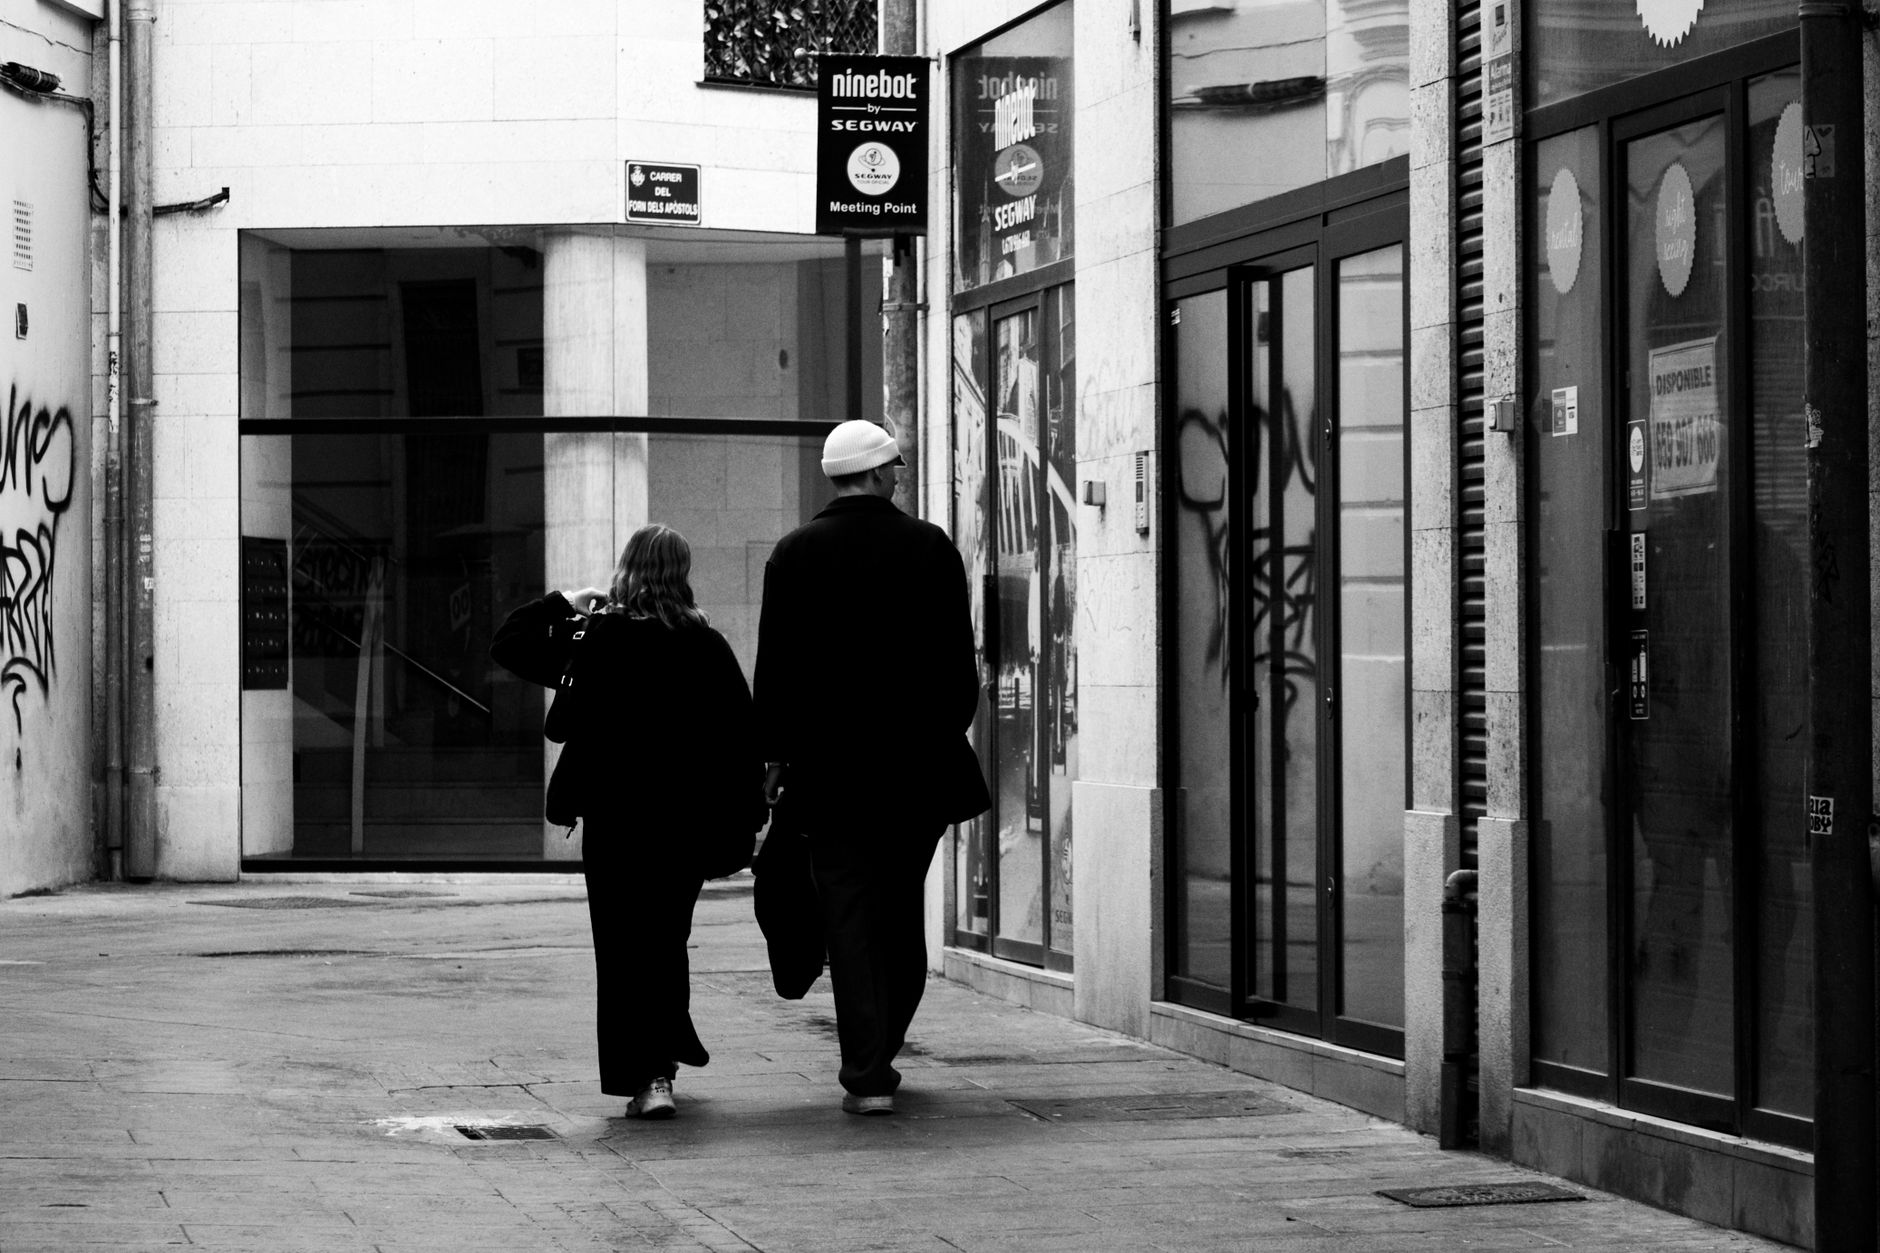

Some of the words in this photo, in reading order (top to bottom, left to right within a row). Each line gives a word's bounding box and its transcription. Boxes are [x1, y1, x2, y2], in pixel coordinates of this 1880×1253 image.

[832, 68, 917, 99] ninebot
[867, 104, 881, 114] by
[995, 74, 1037, 151] ninebot
[831, 120, 916, 132] SEGWAY
[650, 171, 682, 182] CARRER
[655, 187, 671, 197] DEL
[629, 200, 646, 212] FORN
[647, 201, 664, 214] DELS
[830, 201, 881, 215] Meeting
[884, 203, 917, 214] Point
[995, 195, 1037, 231] SEGWAY
[1656, 365, 1712, 396] DISPONIBLE
